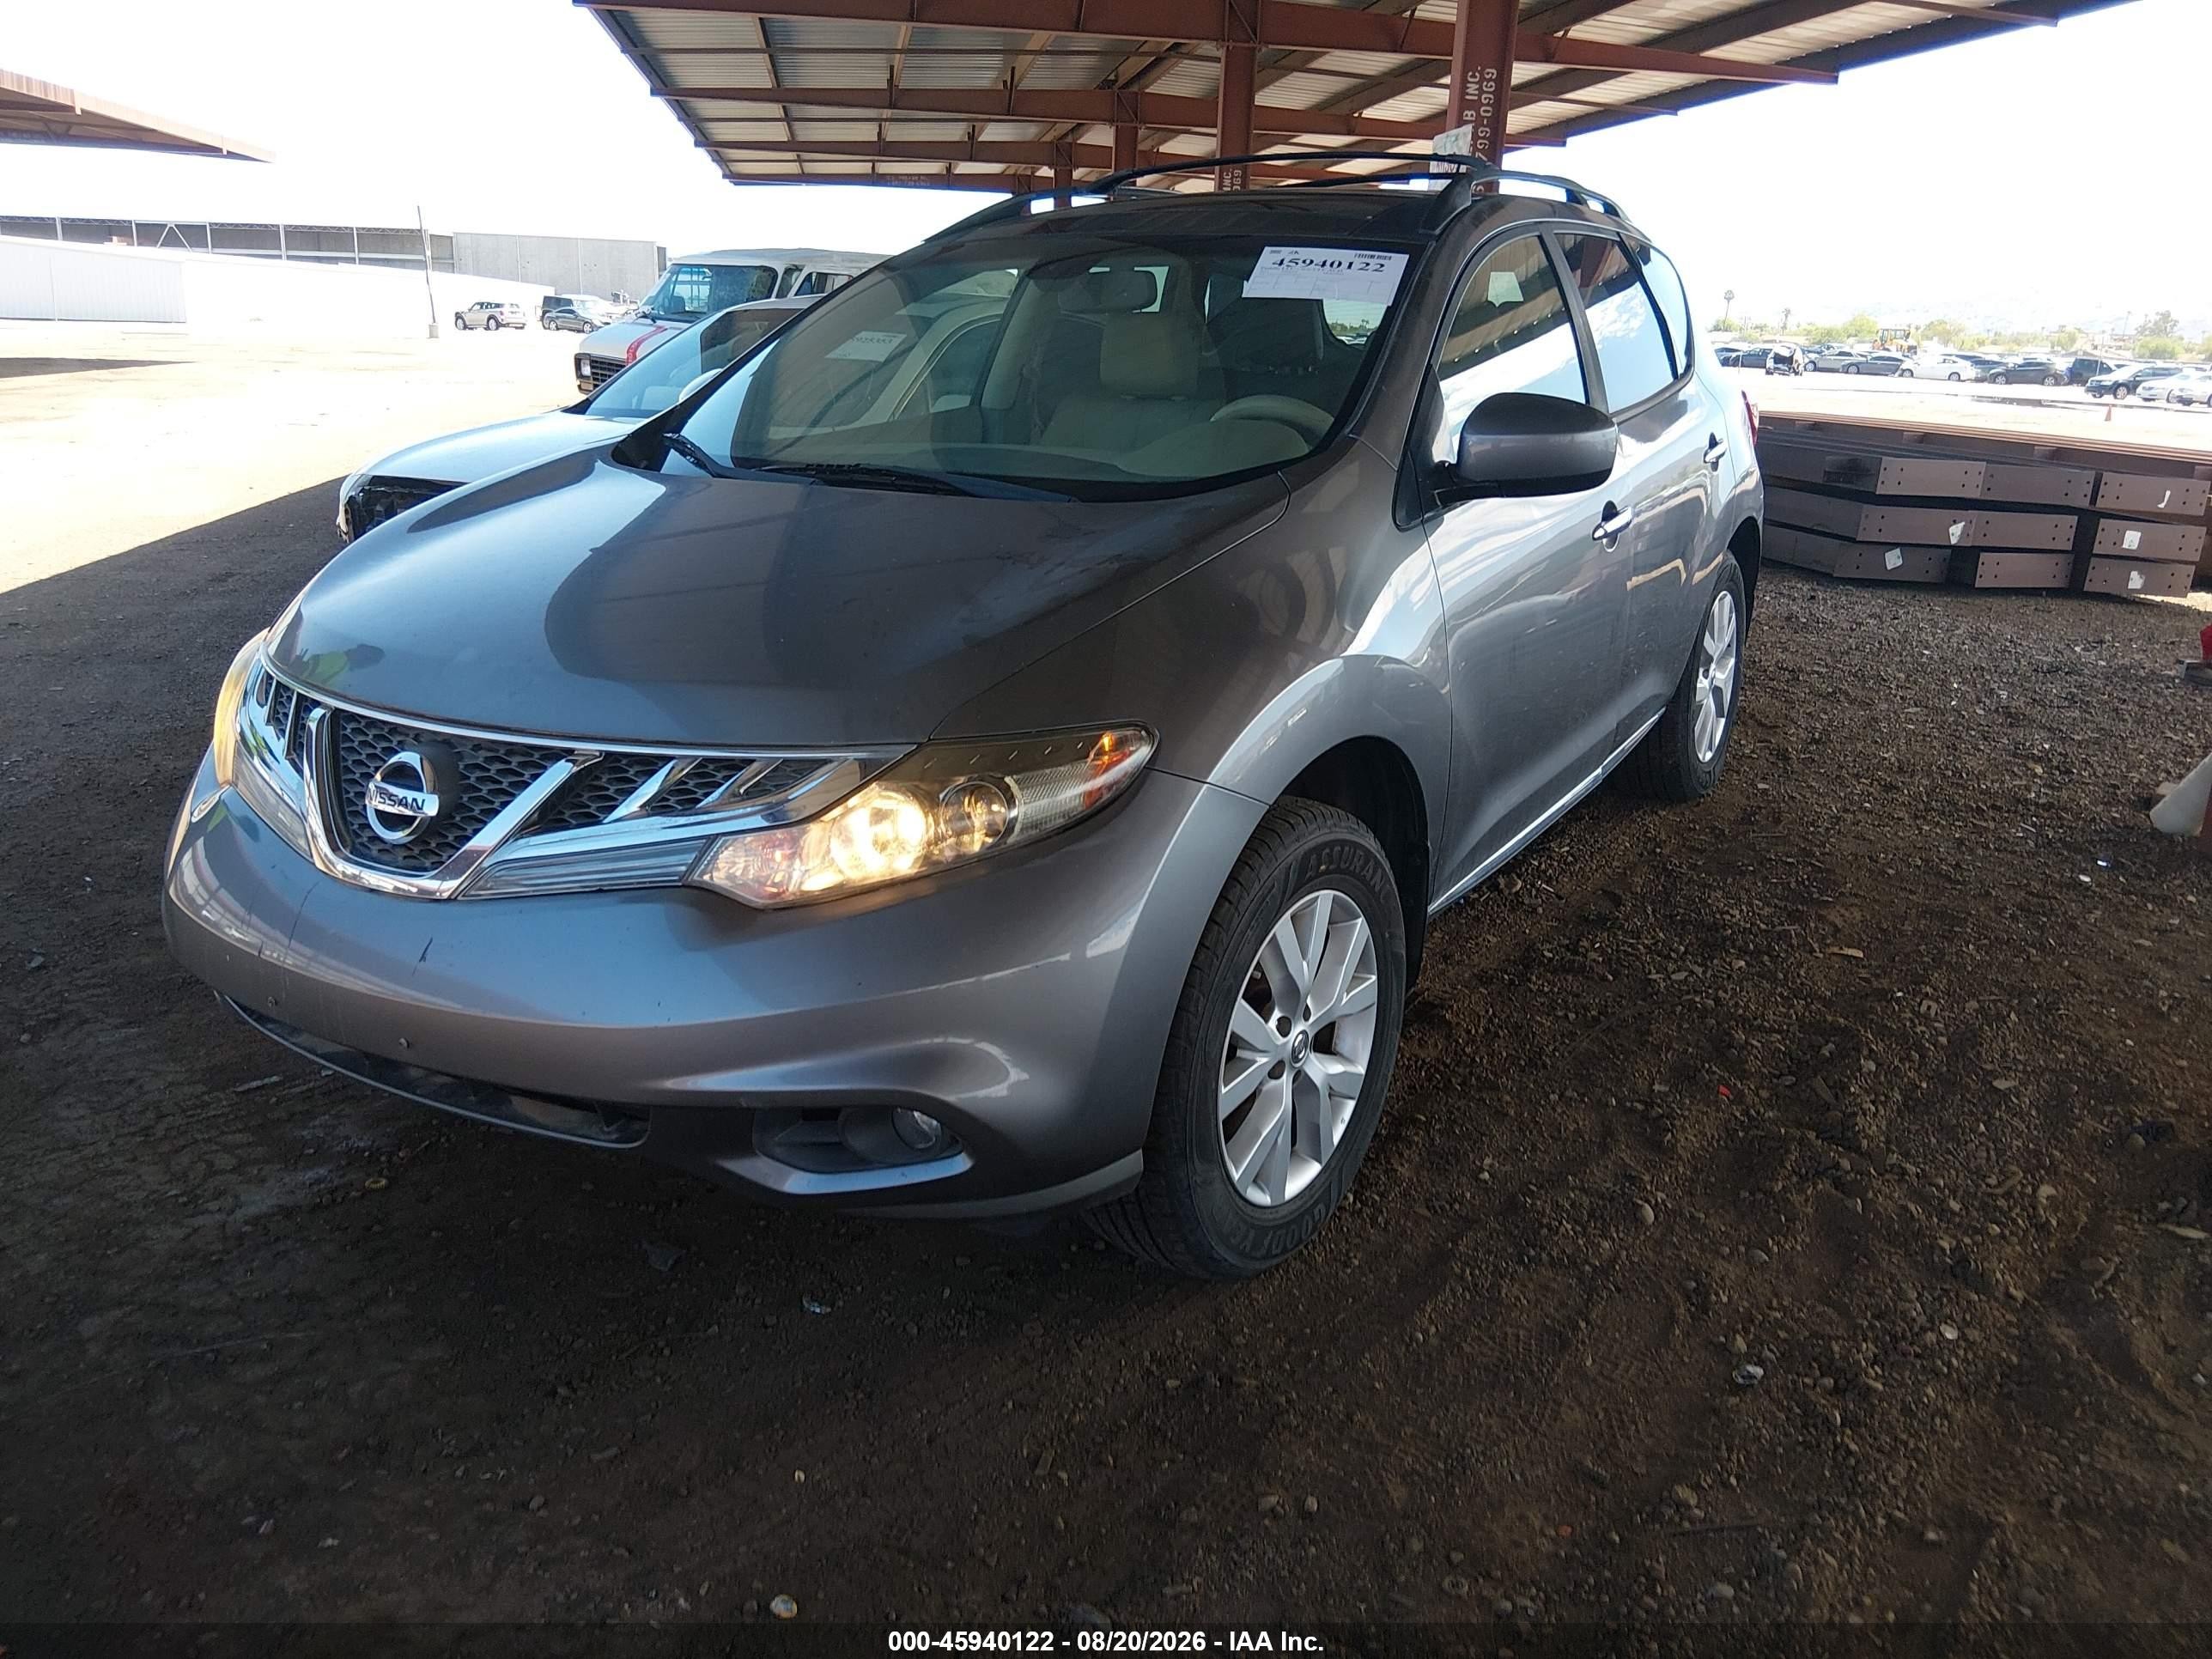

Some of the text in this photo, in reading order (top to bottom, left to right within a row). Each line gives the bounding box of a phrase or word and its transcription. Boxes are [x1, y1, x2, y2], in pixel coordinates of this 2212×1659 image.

[1466, 65, 1480, 100] INC.
[1272, 257, 1385, 273] 45940122
[368, 787, 426, 811] NISSAN
